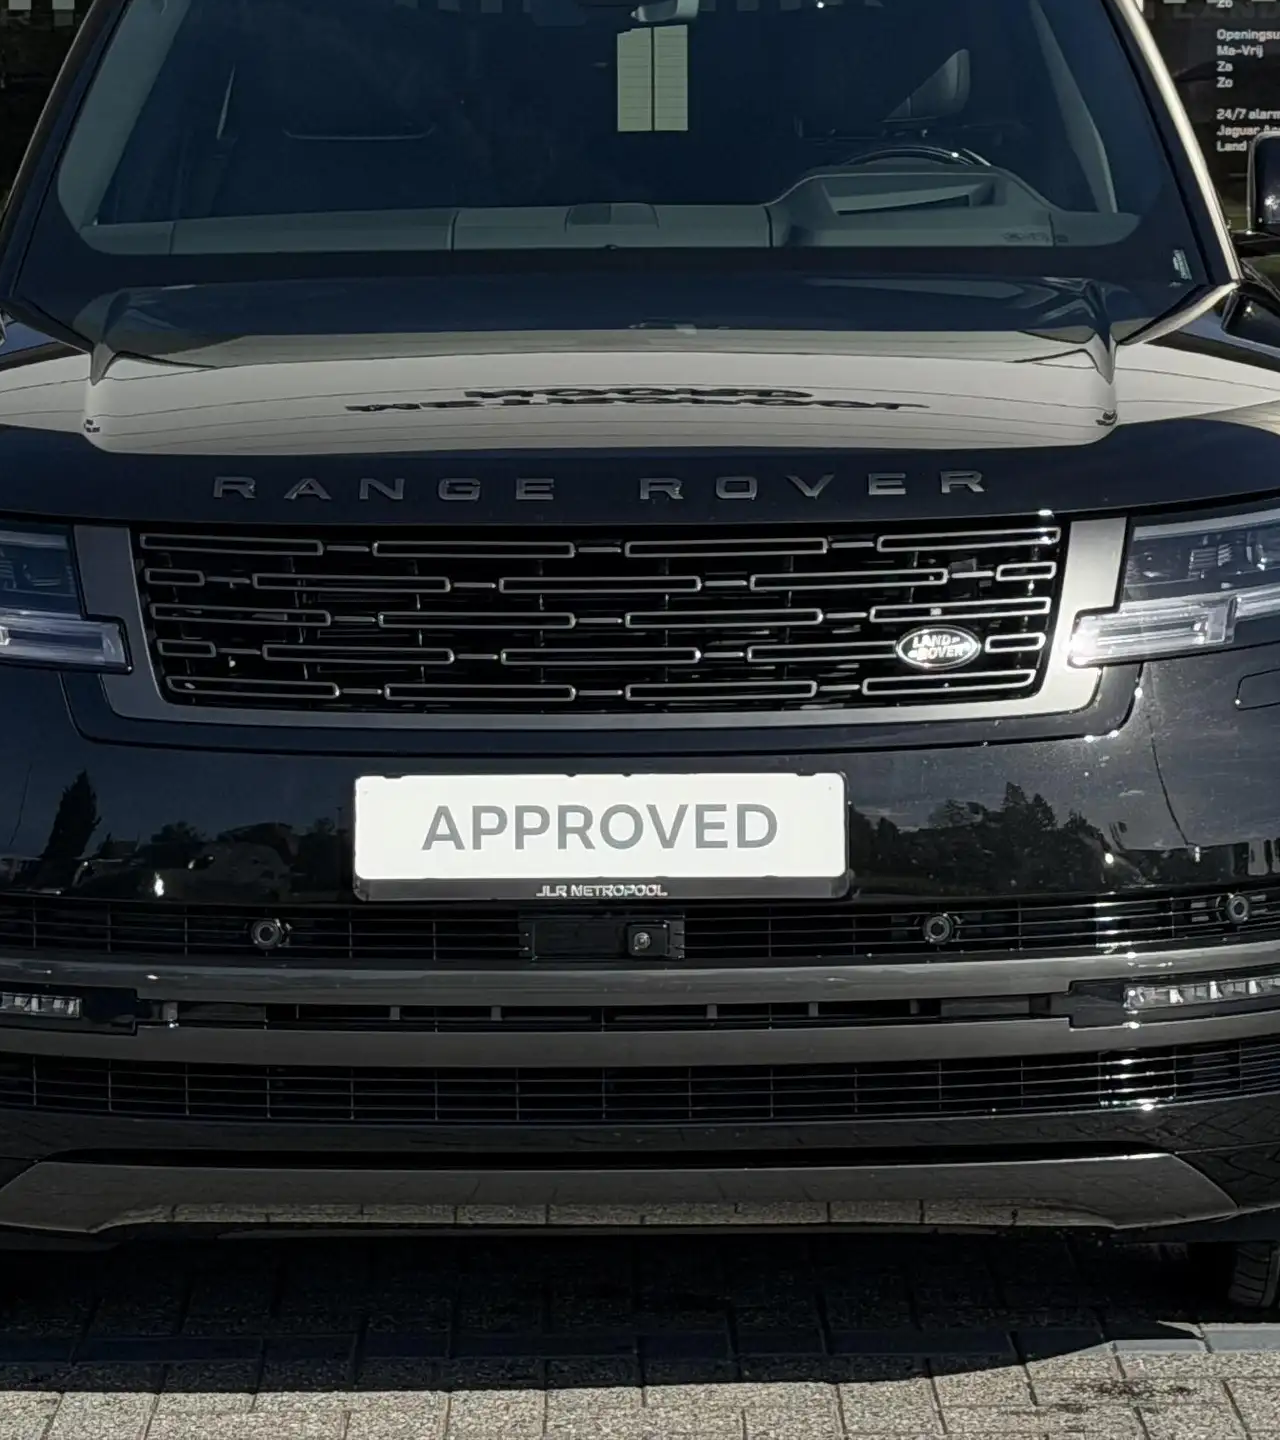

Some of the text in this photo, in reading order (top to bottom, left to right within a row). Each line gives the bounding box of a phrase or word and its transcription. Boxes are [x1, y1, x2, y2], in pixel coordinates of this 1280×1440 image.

[1217, 77, 1234, 88] Zo
[1216, 108, 1247, 120] 24/7
[1216, 124, 1260, 138] Jaguar
[1216, 140, 1247, 152] Land
[213, 469, 985, 501] RANGE ROVER
[912, 634, 952, 648] LAND
[421, 803, 778, 851] APPROVED
[535, 884, 668, 898] JLR METROPOOL
